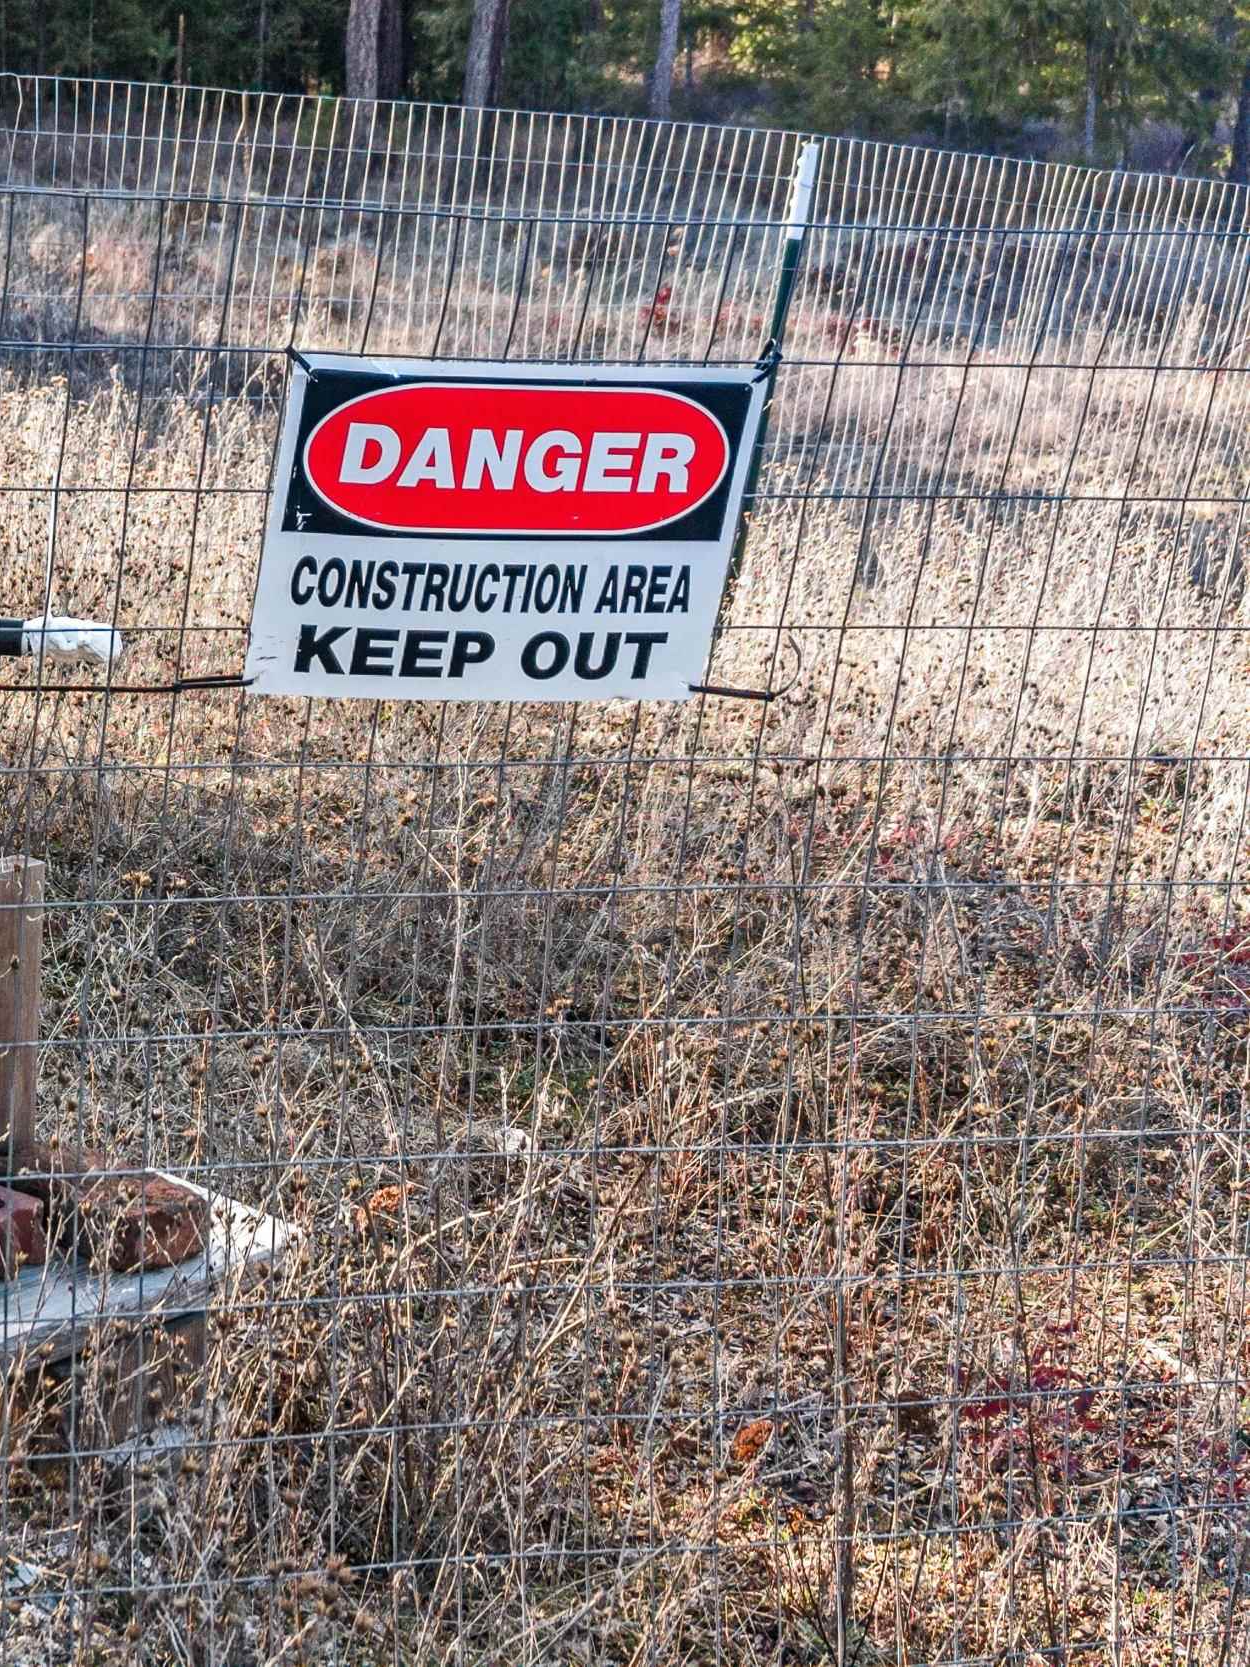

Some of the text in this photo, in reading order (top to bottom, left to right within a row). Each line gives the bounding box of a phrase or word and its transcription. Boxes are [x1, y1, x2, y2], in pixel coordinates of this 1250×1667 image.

[338, 422, 696, 494] DANGER
[291, 556, 691, 614] CONSTRUCTION AREA
[293, 625, 669, 681] KEEP OUT
